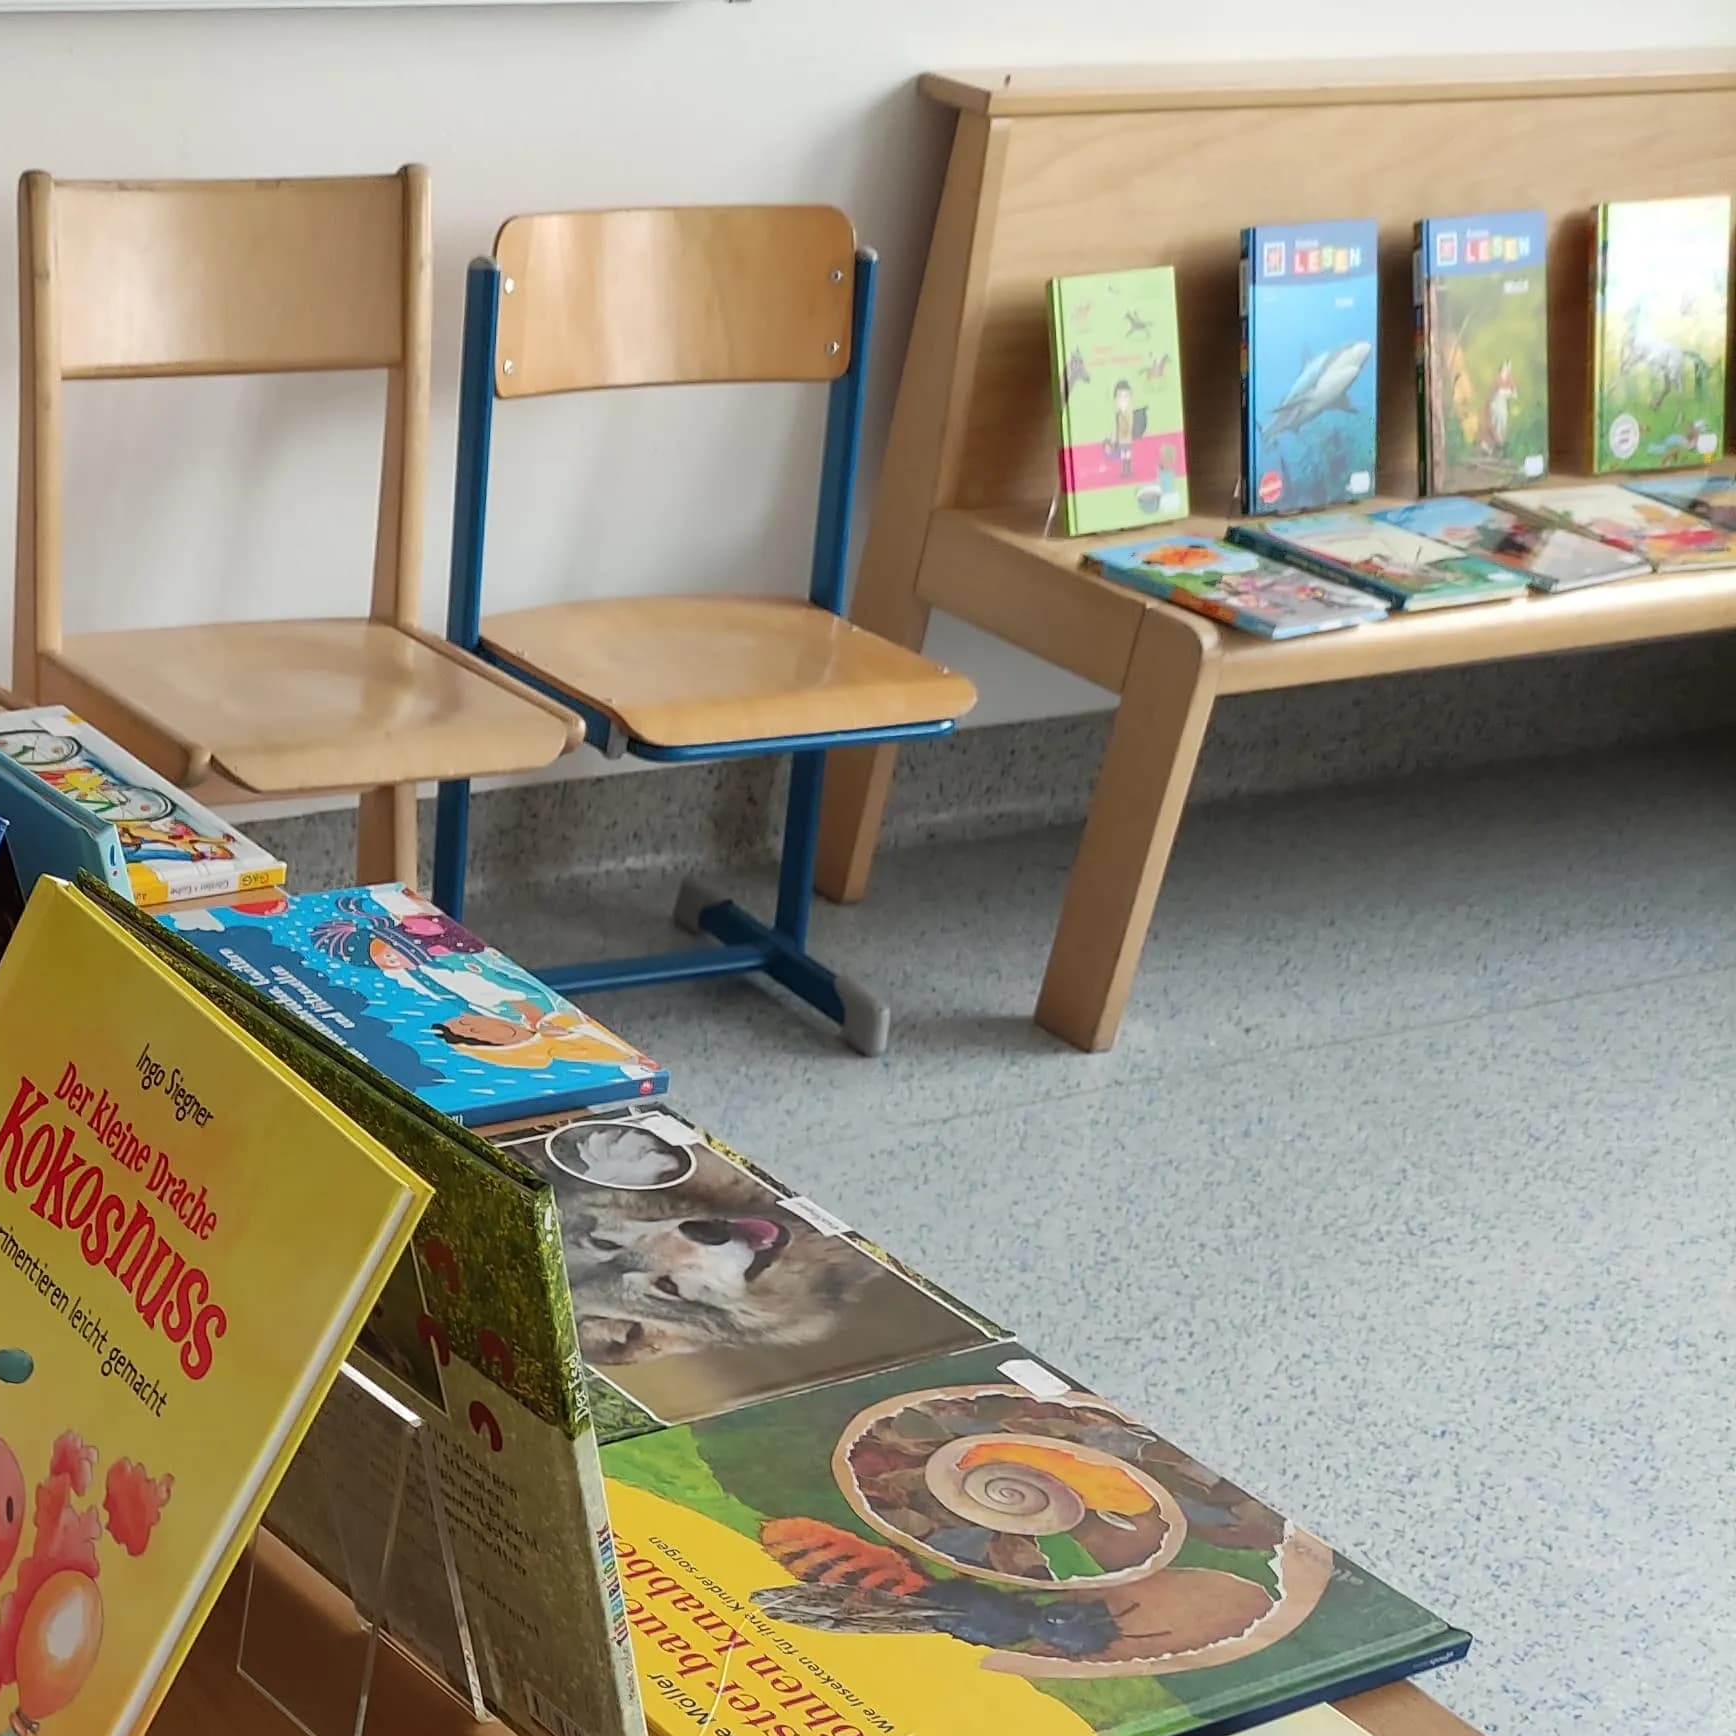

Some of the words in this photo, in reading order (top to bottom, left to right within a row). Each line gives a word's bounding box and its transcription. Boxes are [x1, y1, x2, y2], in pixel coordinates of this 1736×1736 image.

[136, 1043, 165, 1091] Ingo
[165, 1067, 215, 1128] Siegner
[54, 1061, 95, 1119] Der
[90, 1088, 153, 1174] kleine
[145, 1152, 218, 1241] Drache
[67, 1297, 109, 1355] leicht
[100, 1346, 169, 1419] gemacht
[648, 1536, 700, 1574] sorgen
[613, 1534, 755, 1656] knabbe
[695, 1574, 746, 1613] Kinder
[623, 1590, 717, 1679] baue
[744, 1611, 774, 1637] ihre
[773, 1636, 799, 1657] für
[647, 1672, 717, 1727] Möller
[798, 1656, 863, 1708] Insekten
[864, 1709, 895, 1734] Wie
